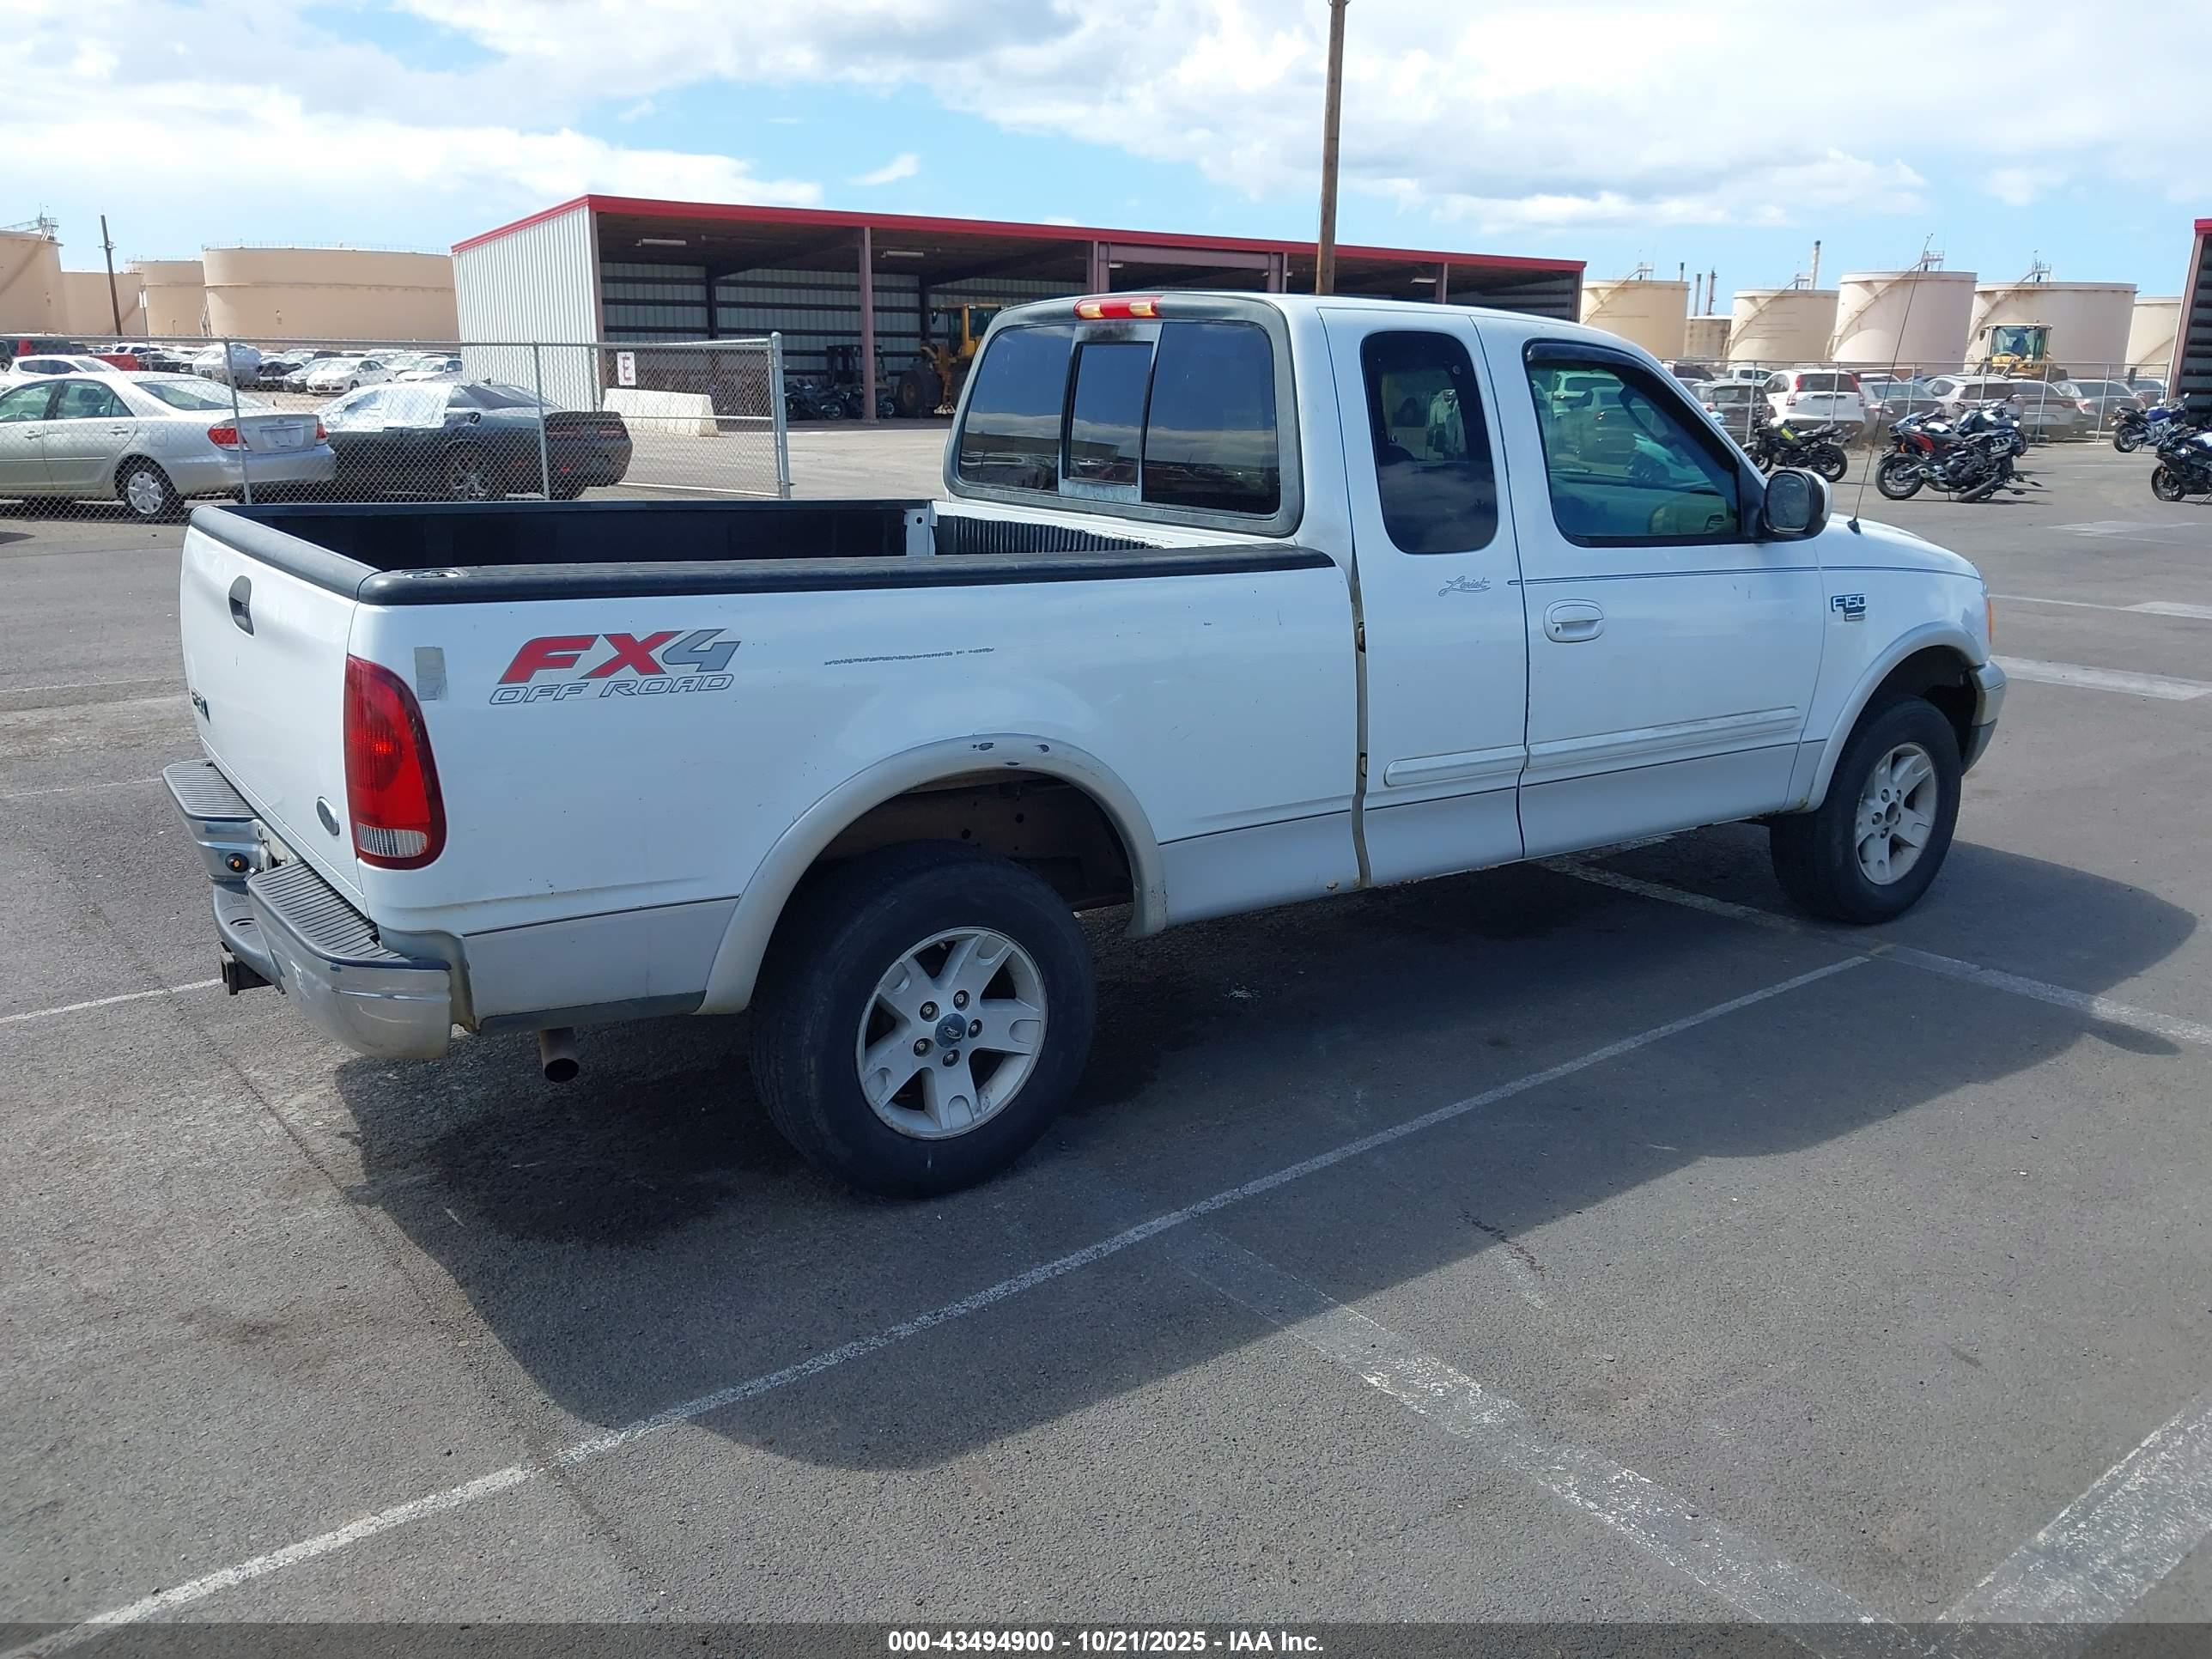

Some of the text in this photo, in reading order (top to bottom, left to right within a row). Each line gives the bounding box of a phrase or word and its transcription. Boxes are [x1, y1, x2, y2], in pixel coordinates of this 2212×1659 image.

[622, 356, 633, 381] E
[496, 628, 742, 685] FX4
[489, 673, 734, 705] OFF ROAD
